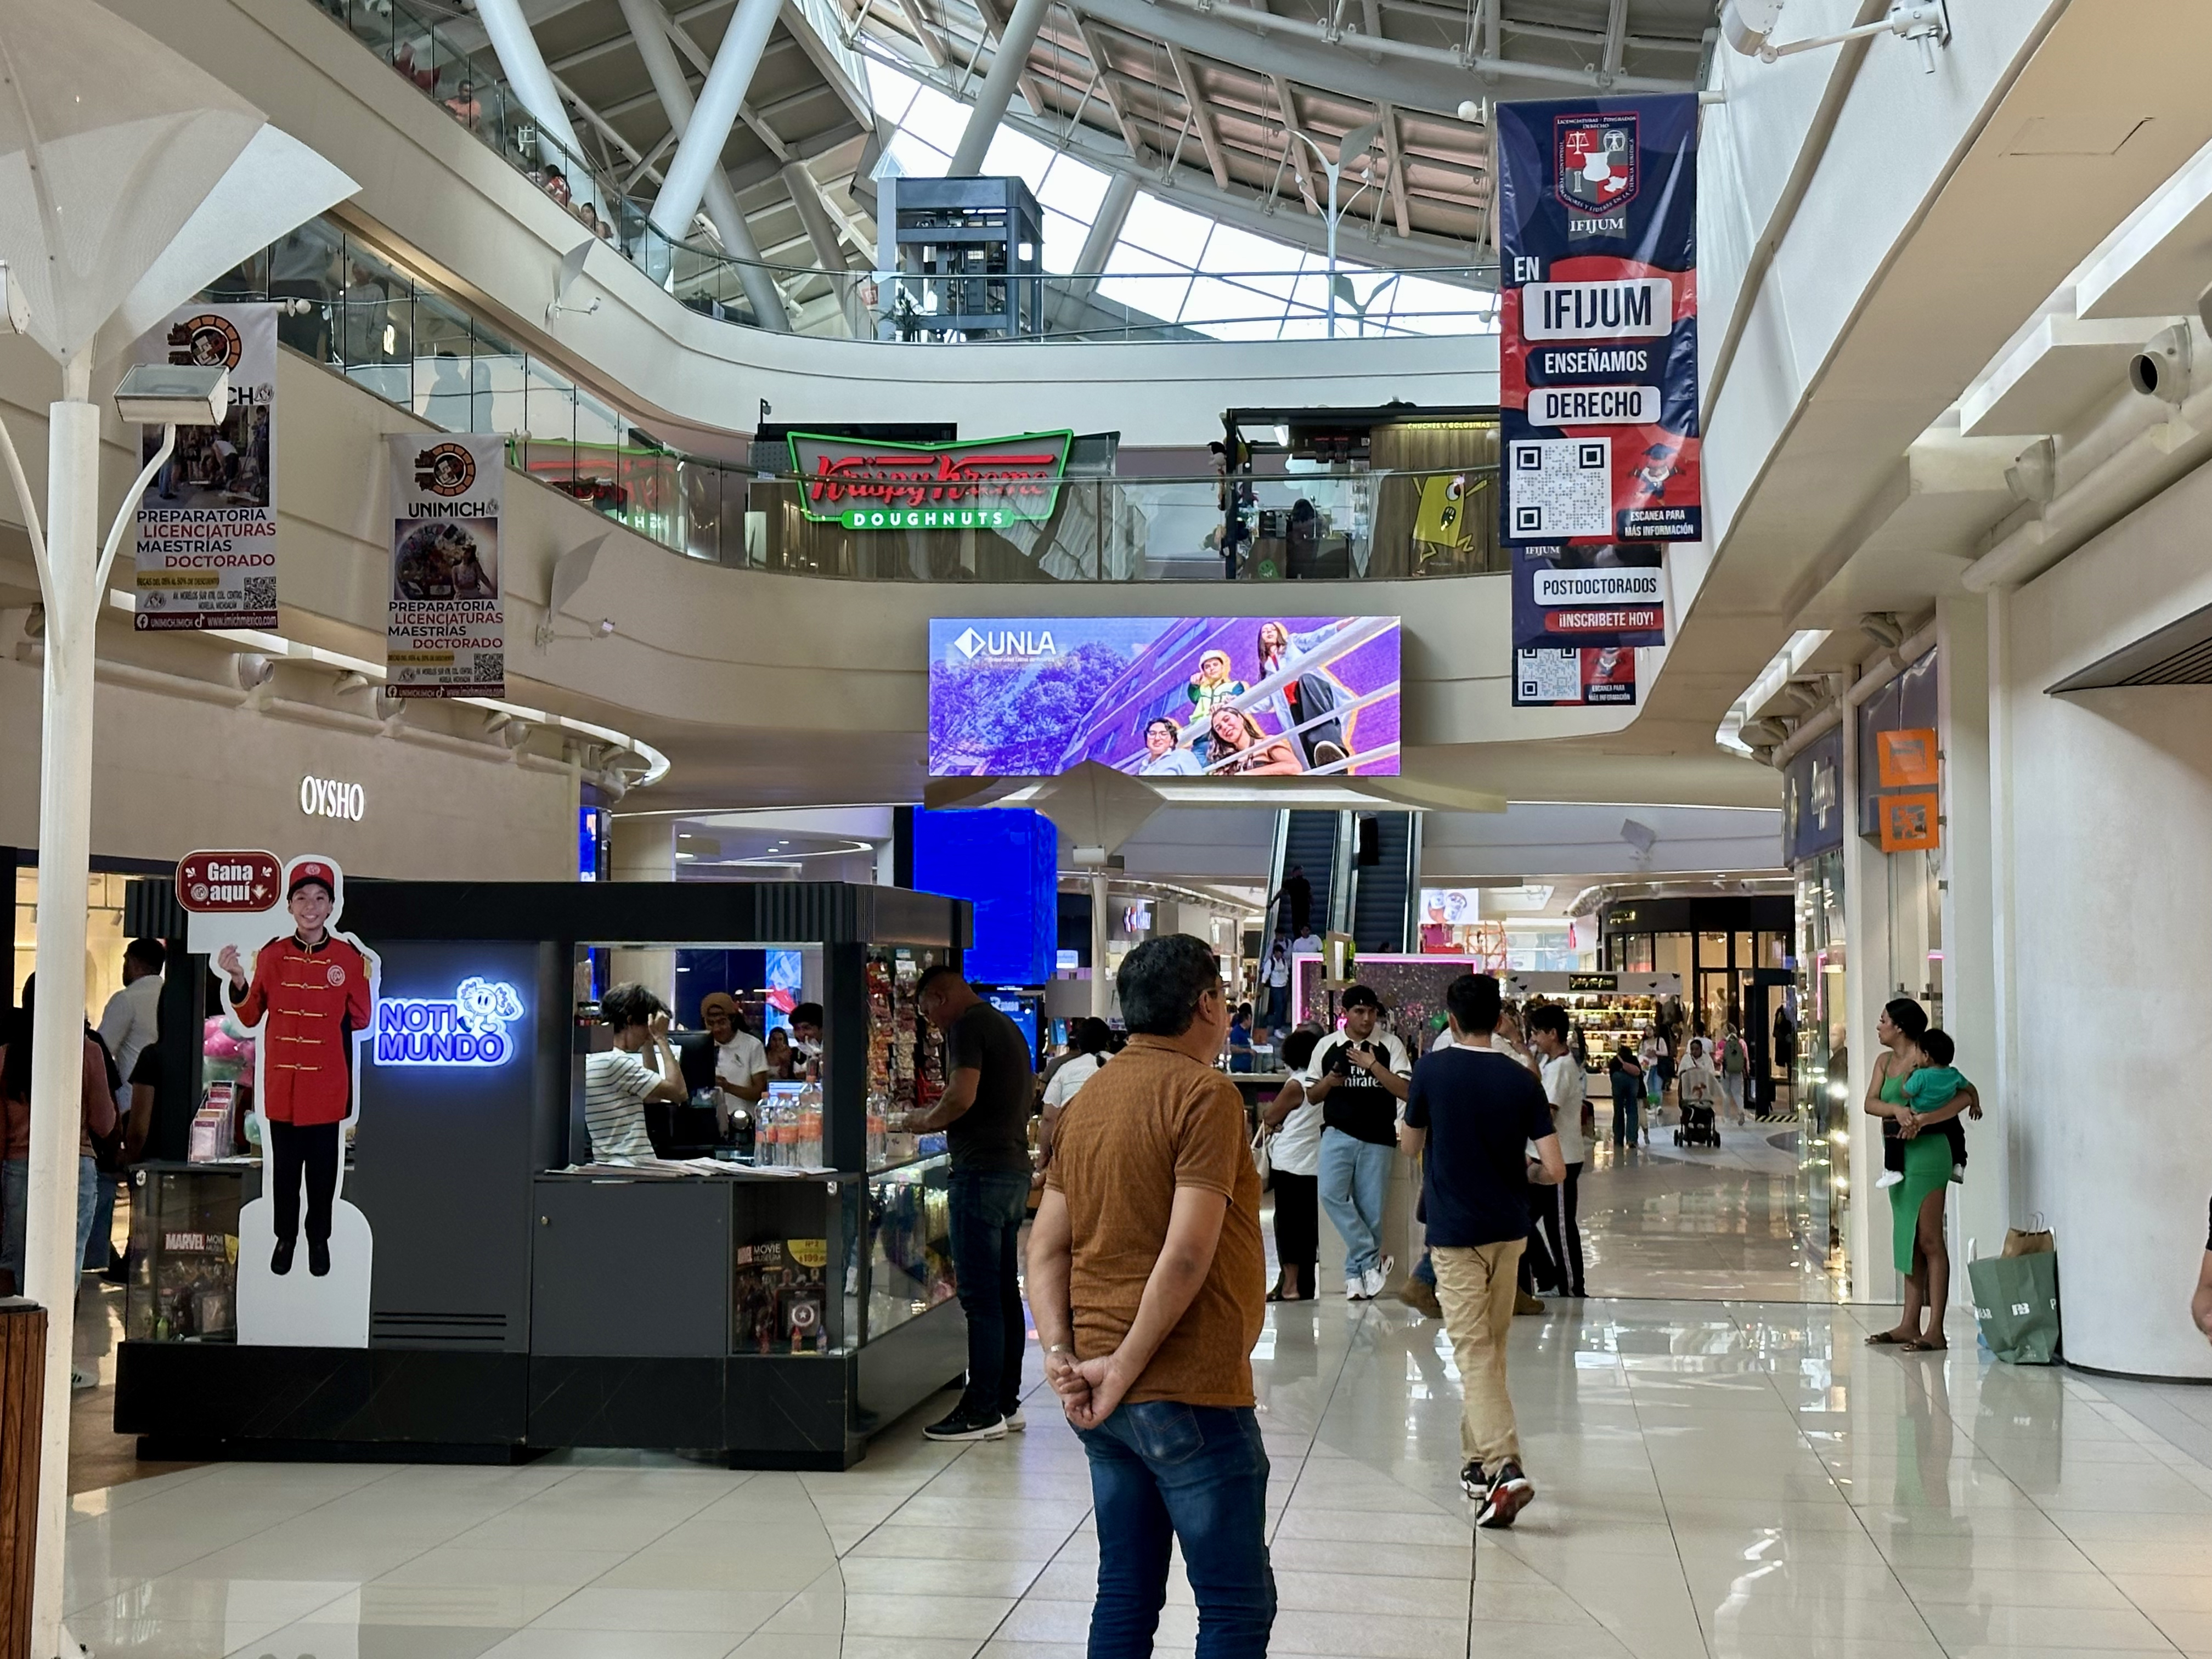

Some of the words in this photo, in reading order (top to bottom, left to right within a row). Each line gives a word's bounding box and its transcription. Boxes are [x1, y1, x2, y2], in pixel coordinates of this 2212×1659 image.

[1570, 218, 1624, 234] IFIJUM
[1514, 256, 1539, 281] EN
[1544, 286, 1652, 330] IFIJUM
[1544, 348, 1647, 374] ENSEÑAMOS
[1545, 391, 1642, 419] DERECHO
[811, 455, 937, 507] Krispy
[933, 454, 1056, 500] Kreme
[137, 509, 267, 523] PREPARATORIA
[409, 502, 485, 518] UNIMICH
[1630, 510, 1664, 521] ESCANEA
[1666, 510, 1685, 520] PARA
[854, 511, 1003, 527] DOUGHNUTS
[144, 522, 276, 538] LICENCIATURAS
[1624, 525, 1641, 536] MÁS
[1643, 522, 1694, 536] INFORMACIÓN
[137, 537, 232, 553] MAESTRÍAS
[1525, 546, 1560, 556] IFIJUM
[165, 554, 275, 568] DOCTORADO
[1543, 578, 1656, 596] POSTDOCTORADOS
[388, 601, 495, 612] PREPARATORIA
[395, 612, 504, 625] LICENCIATURAS
[1629, 612, 1654, 627] HOY!
[388, 623, 466, 636] MAESTRÍAS
[413, 638, 503, 648] DOCTORADO
[988, 631, 1057, 655] UNLA
[301, 776, 364, 821] OYSHO
[207, 862, 253, 882] Gana
[210, 881, 250, 903] aquí
[380, 1003, 457, 1032] NOTI
[379, 1032, 504, 1062] MUNDO
[1351, 1065, 1366, 1076] Fly
[1345, 1075, 1383, 1087] mirate
[165, 1234, 205, 1250] MARVEL
[753, 1243, 781, 1254] MOVIE
